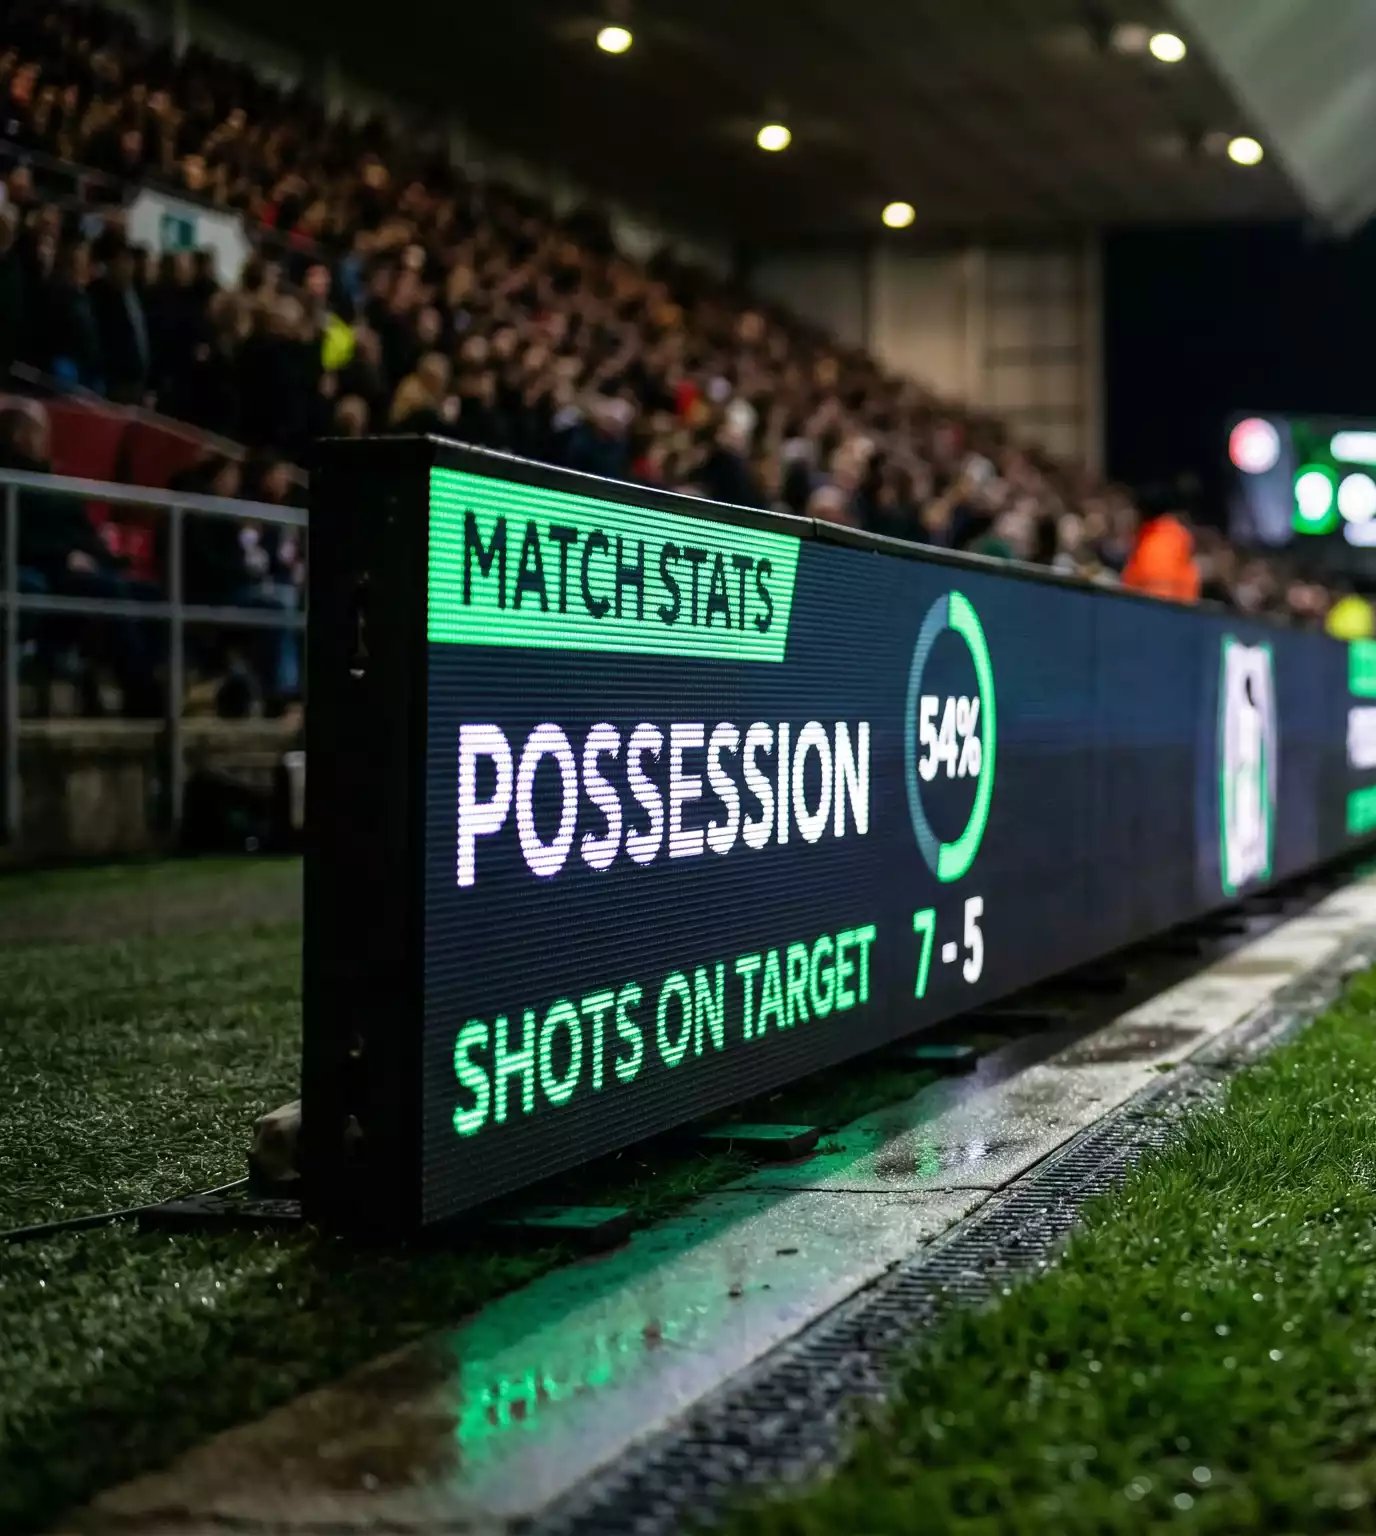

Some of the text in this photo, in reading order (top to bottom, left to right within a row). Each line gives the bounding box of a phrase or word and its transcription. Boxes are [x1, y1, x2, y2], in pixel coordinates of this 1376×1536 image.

[463, 509, 775, 633] MATCH STATS
[456, 721, 870, 887] POSSESSION
[918, 695, 983, 782] 54%
[452, 981, 644, 1136] SHOTS
[655, 953, 726, 1068] ON
[735, 924, 877, 1040] TARGET
[912, 907, 936, 999] 7
[962, 896, 984, 985] 5
